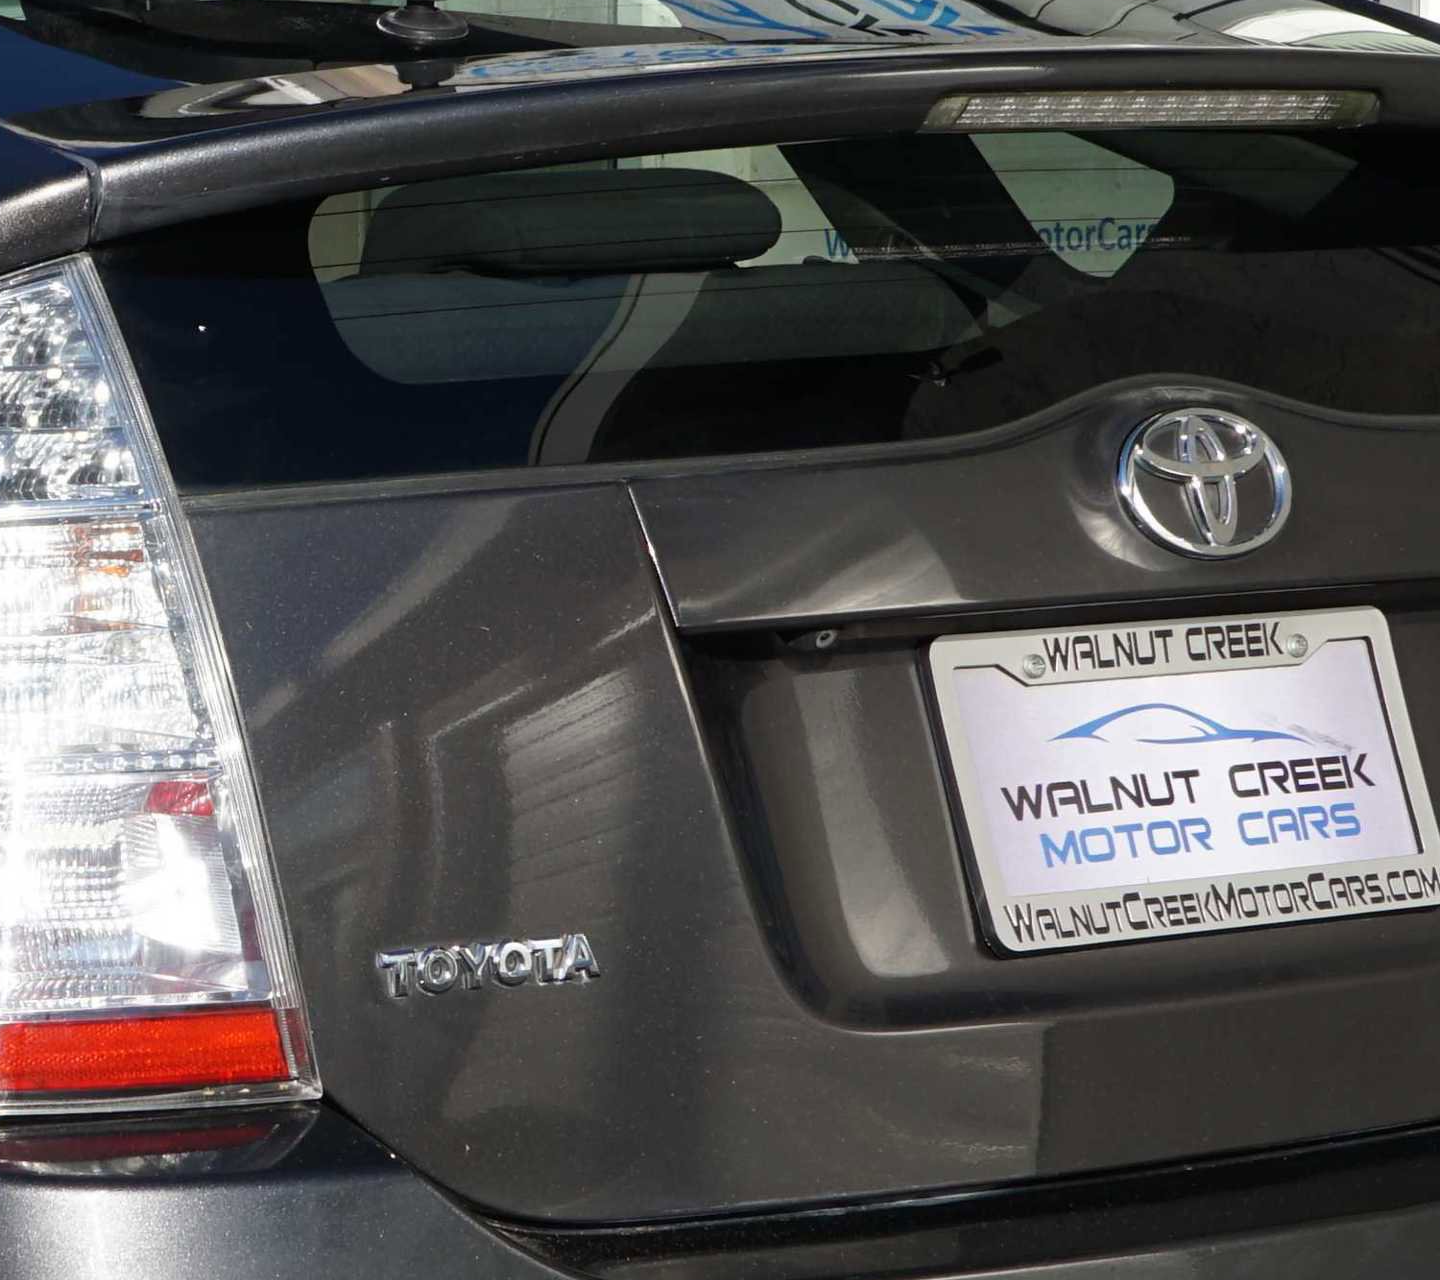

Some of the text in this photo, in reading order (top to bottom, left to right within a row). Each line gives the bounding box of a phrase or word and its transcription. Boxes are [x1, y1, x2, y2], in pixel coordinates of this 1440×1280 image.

[1043, 621, 1284, 670] WALNUT CREEK
[1001, 753, 1376, 820] WALNUT CREEK
[1040, 802, 1361, 868] MOTOR CARS
[375, 933, 601, 998] TOYOTA
